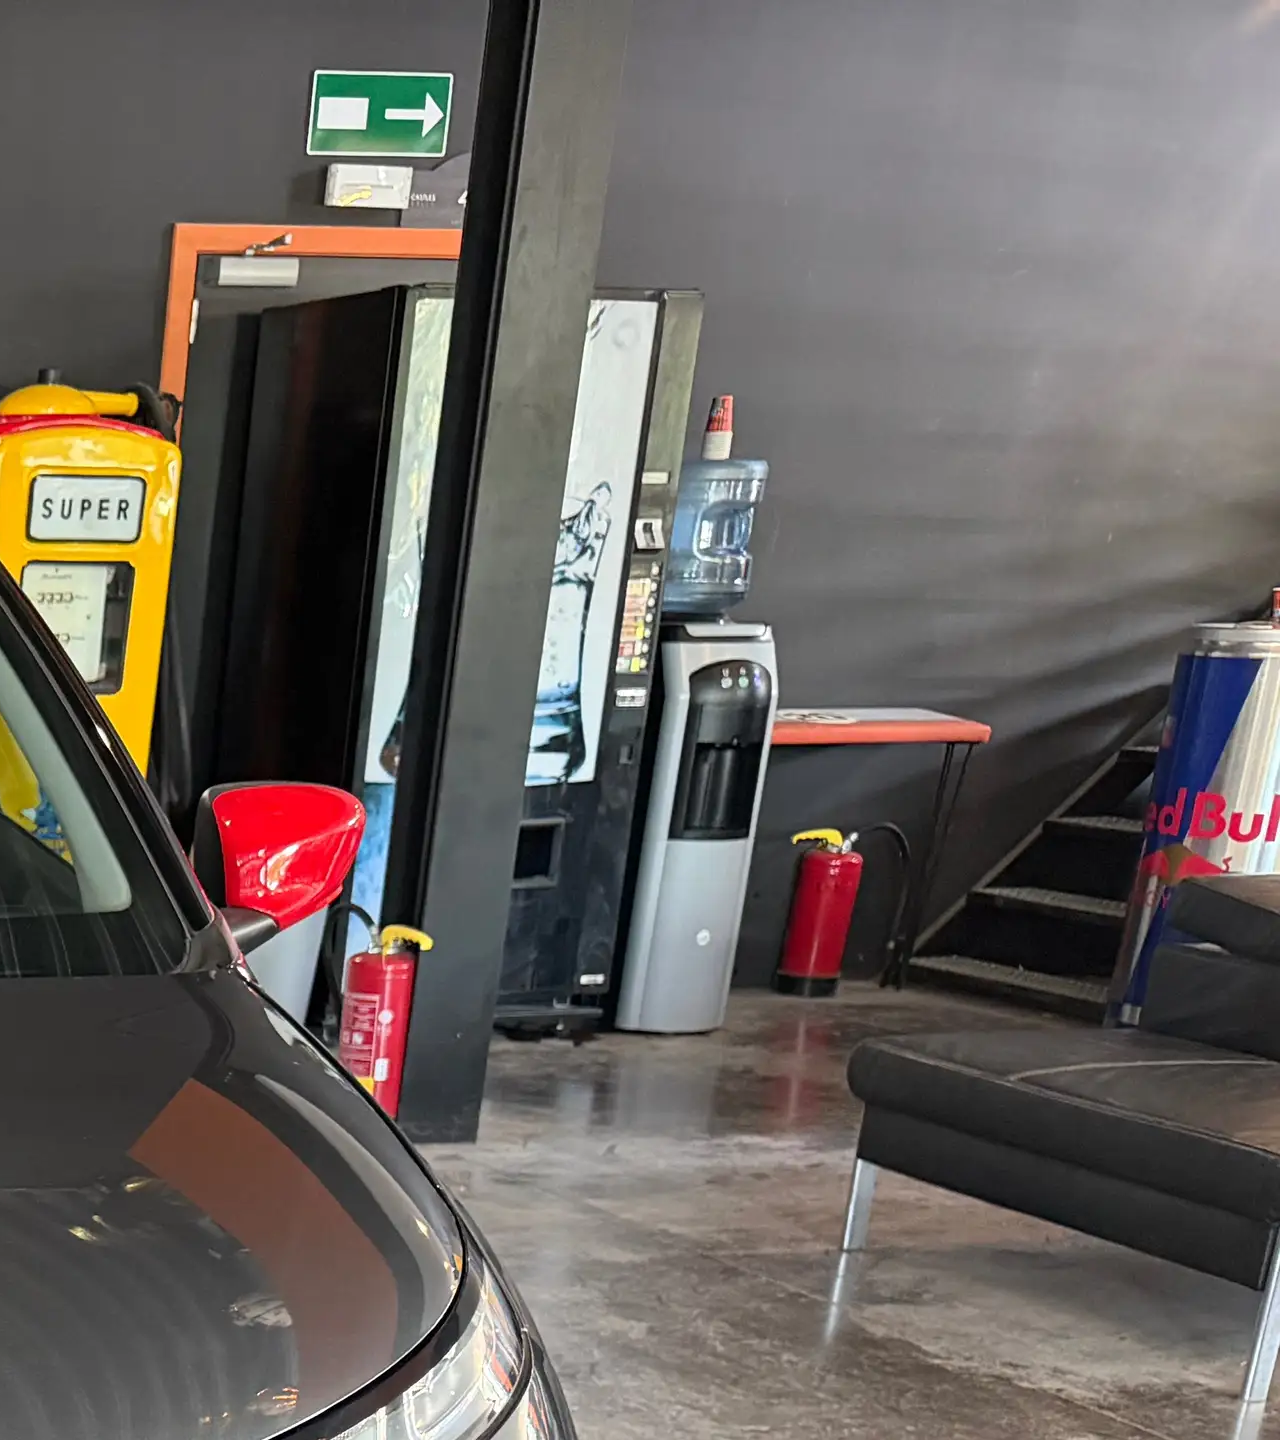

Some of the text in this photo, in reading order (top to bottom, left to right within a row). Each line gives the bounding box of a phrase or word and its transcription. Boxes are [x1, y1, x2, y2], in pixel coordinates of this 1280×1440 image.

[41, 497, 130, 521] SUPER
[1144, 787, 1280, 843] ed Bul
